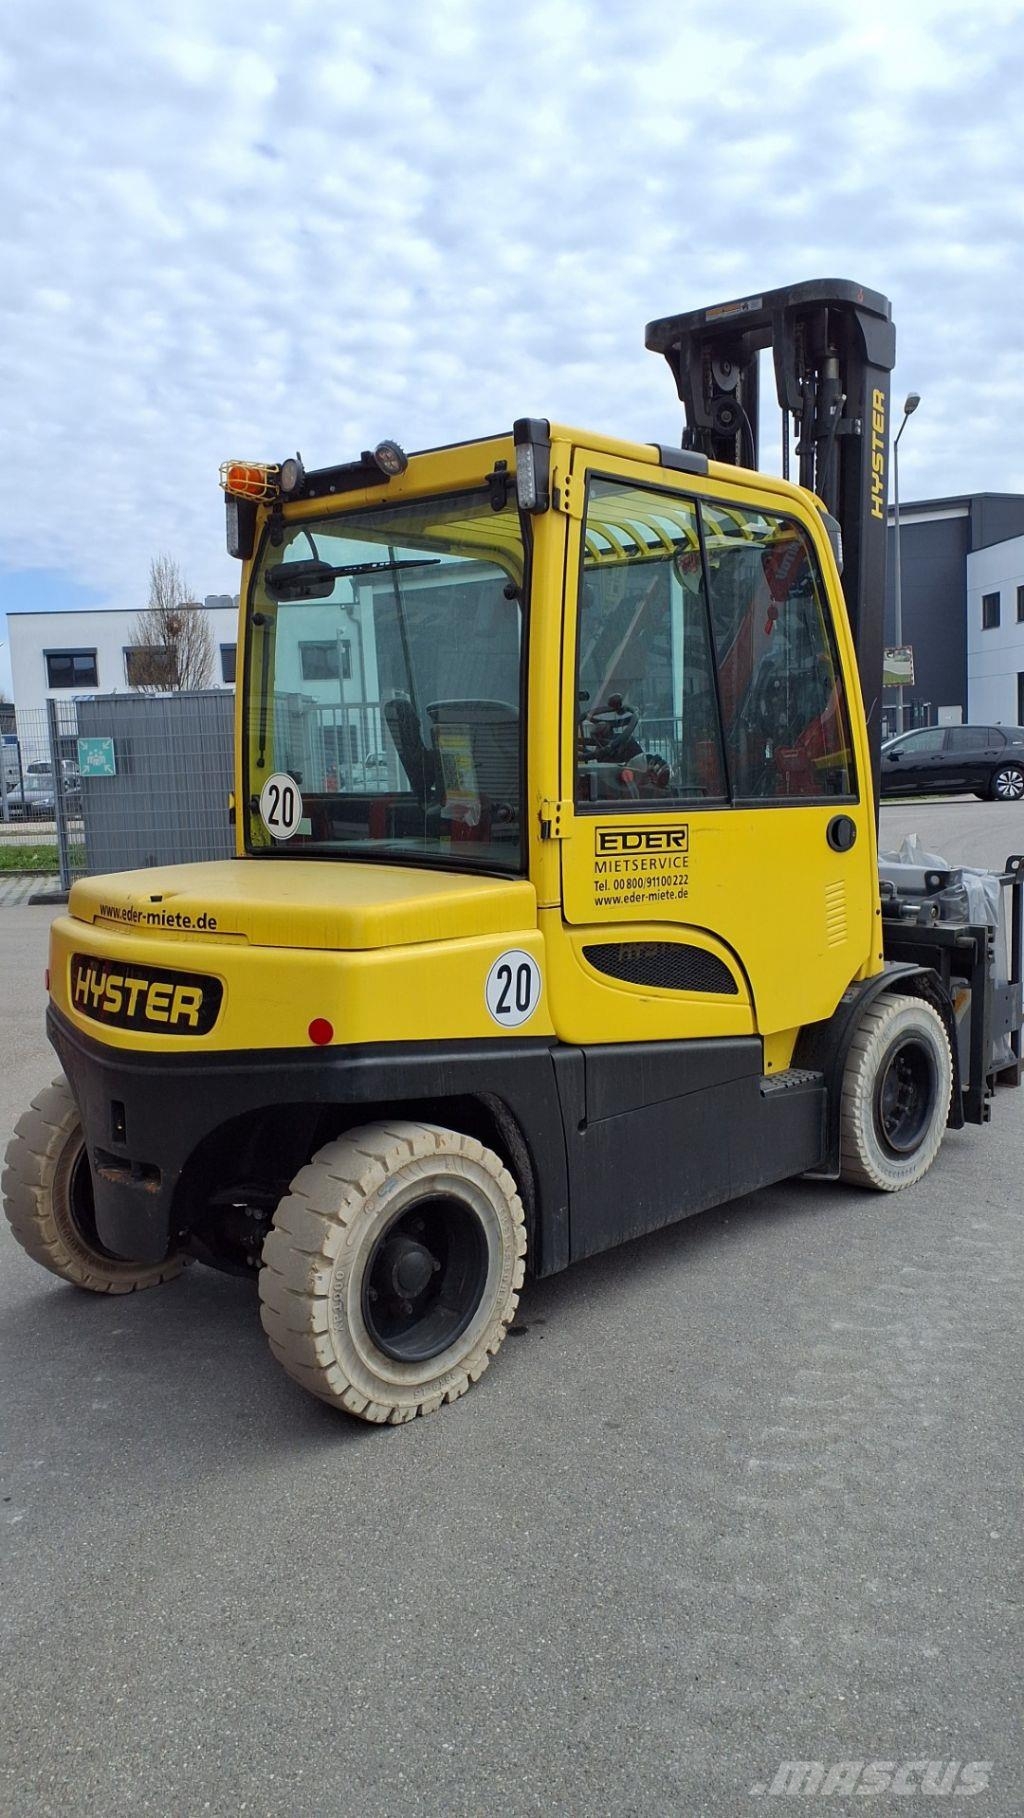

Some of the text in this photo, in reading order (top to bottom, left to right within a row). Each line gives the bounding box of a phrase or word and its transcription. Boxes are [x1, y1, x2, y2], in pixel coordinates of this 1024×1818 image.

[871, 388, 885, 520] HYSTER
[268, 784, 294, 828] 20
[599, 830, 686, 850] EDER
[594, 856, 689, 873] MIETSERVICE
[594, 879, 610, 891] Tel.
[594, 888, 689, 906] www.eder-miete.de
[99, 904, 217, 930] www.eder-miete.de
[75, 966, 204, 1027] HYSTER
[495, 962, 532, 1014] 20
